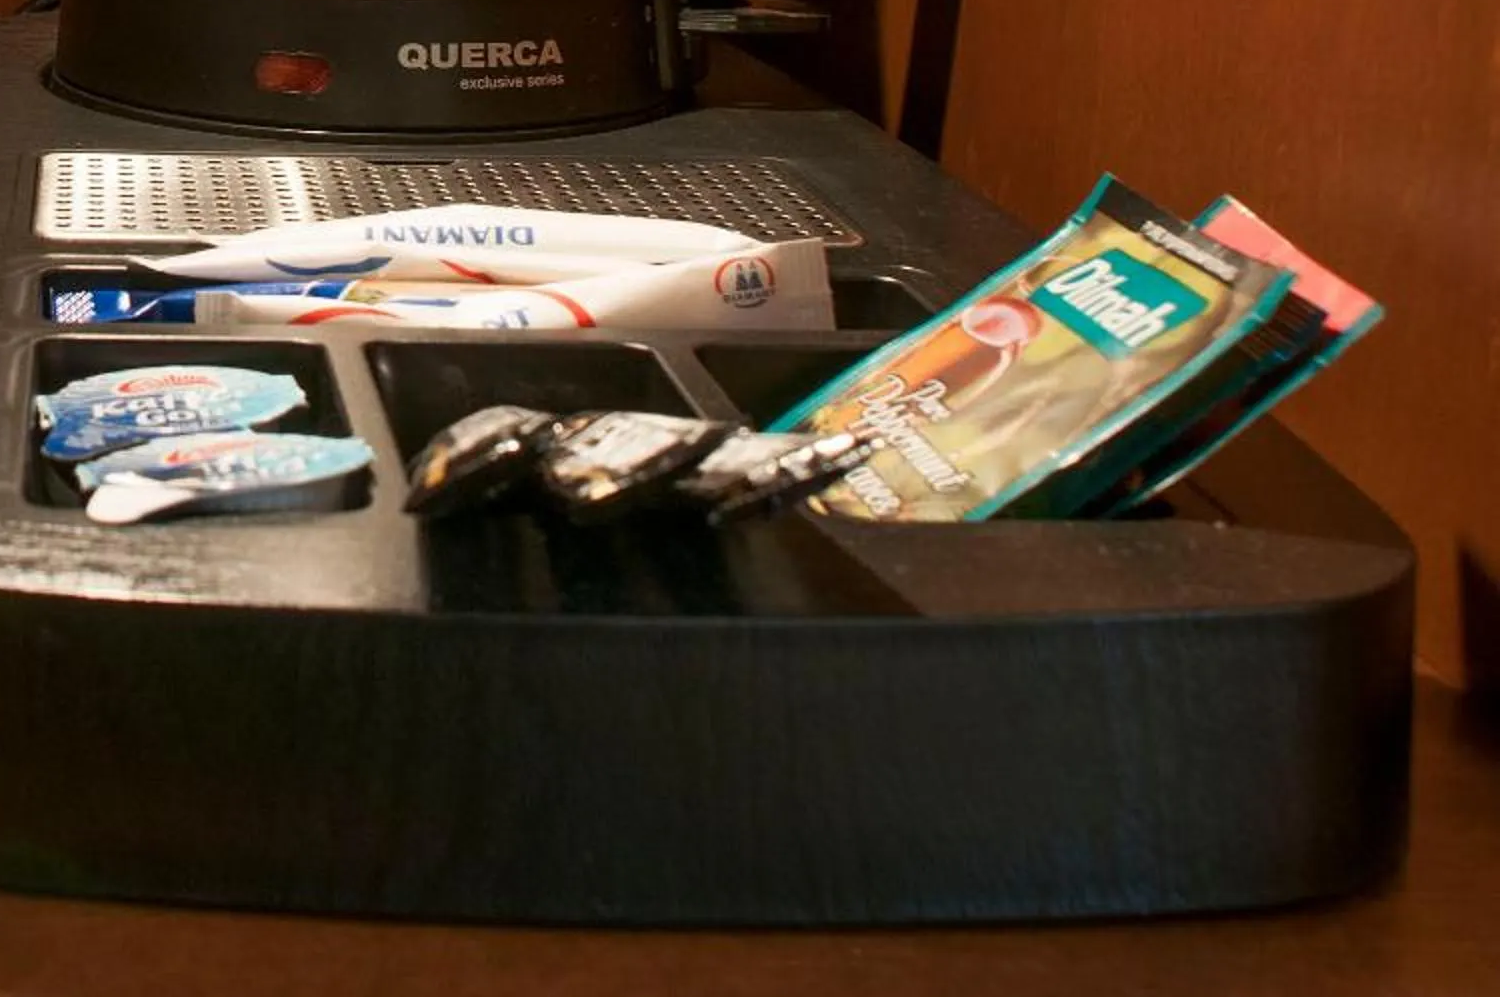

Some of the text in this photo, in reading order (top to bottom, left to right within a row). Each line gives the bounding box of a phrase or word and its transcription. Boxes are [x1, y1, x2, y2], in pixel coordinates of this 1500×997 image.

[399, 39, 564, 70] QUERCA
[460, 73, 565, 90] exclusive series
[1044, 258, 1177, 346] Dilmah
